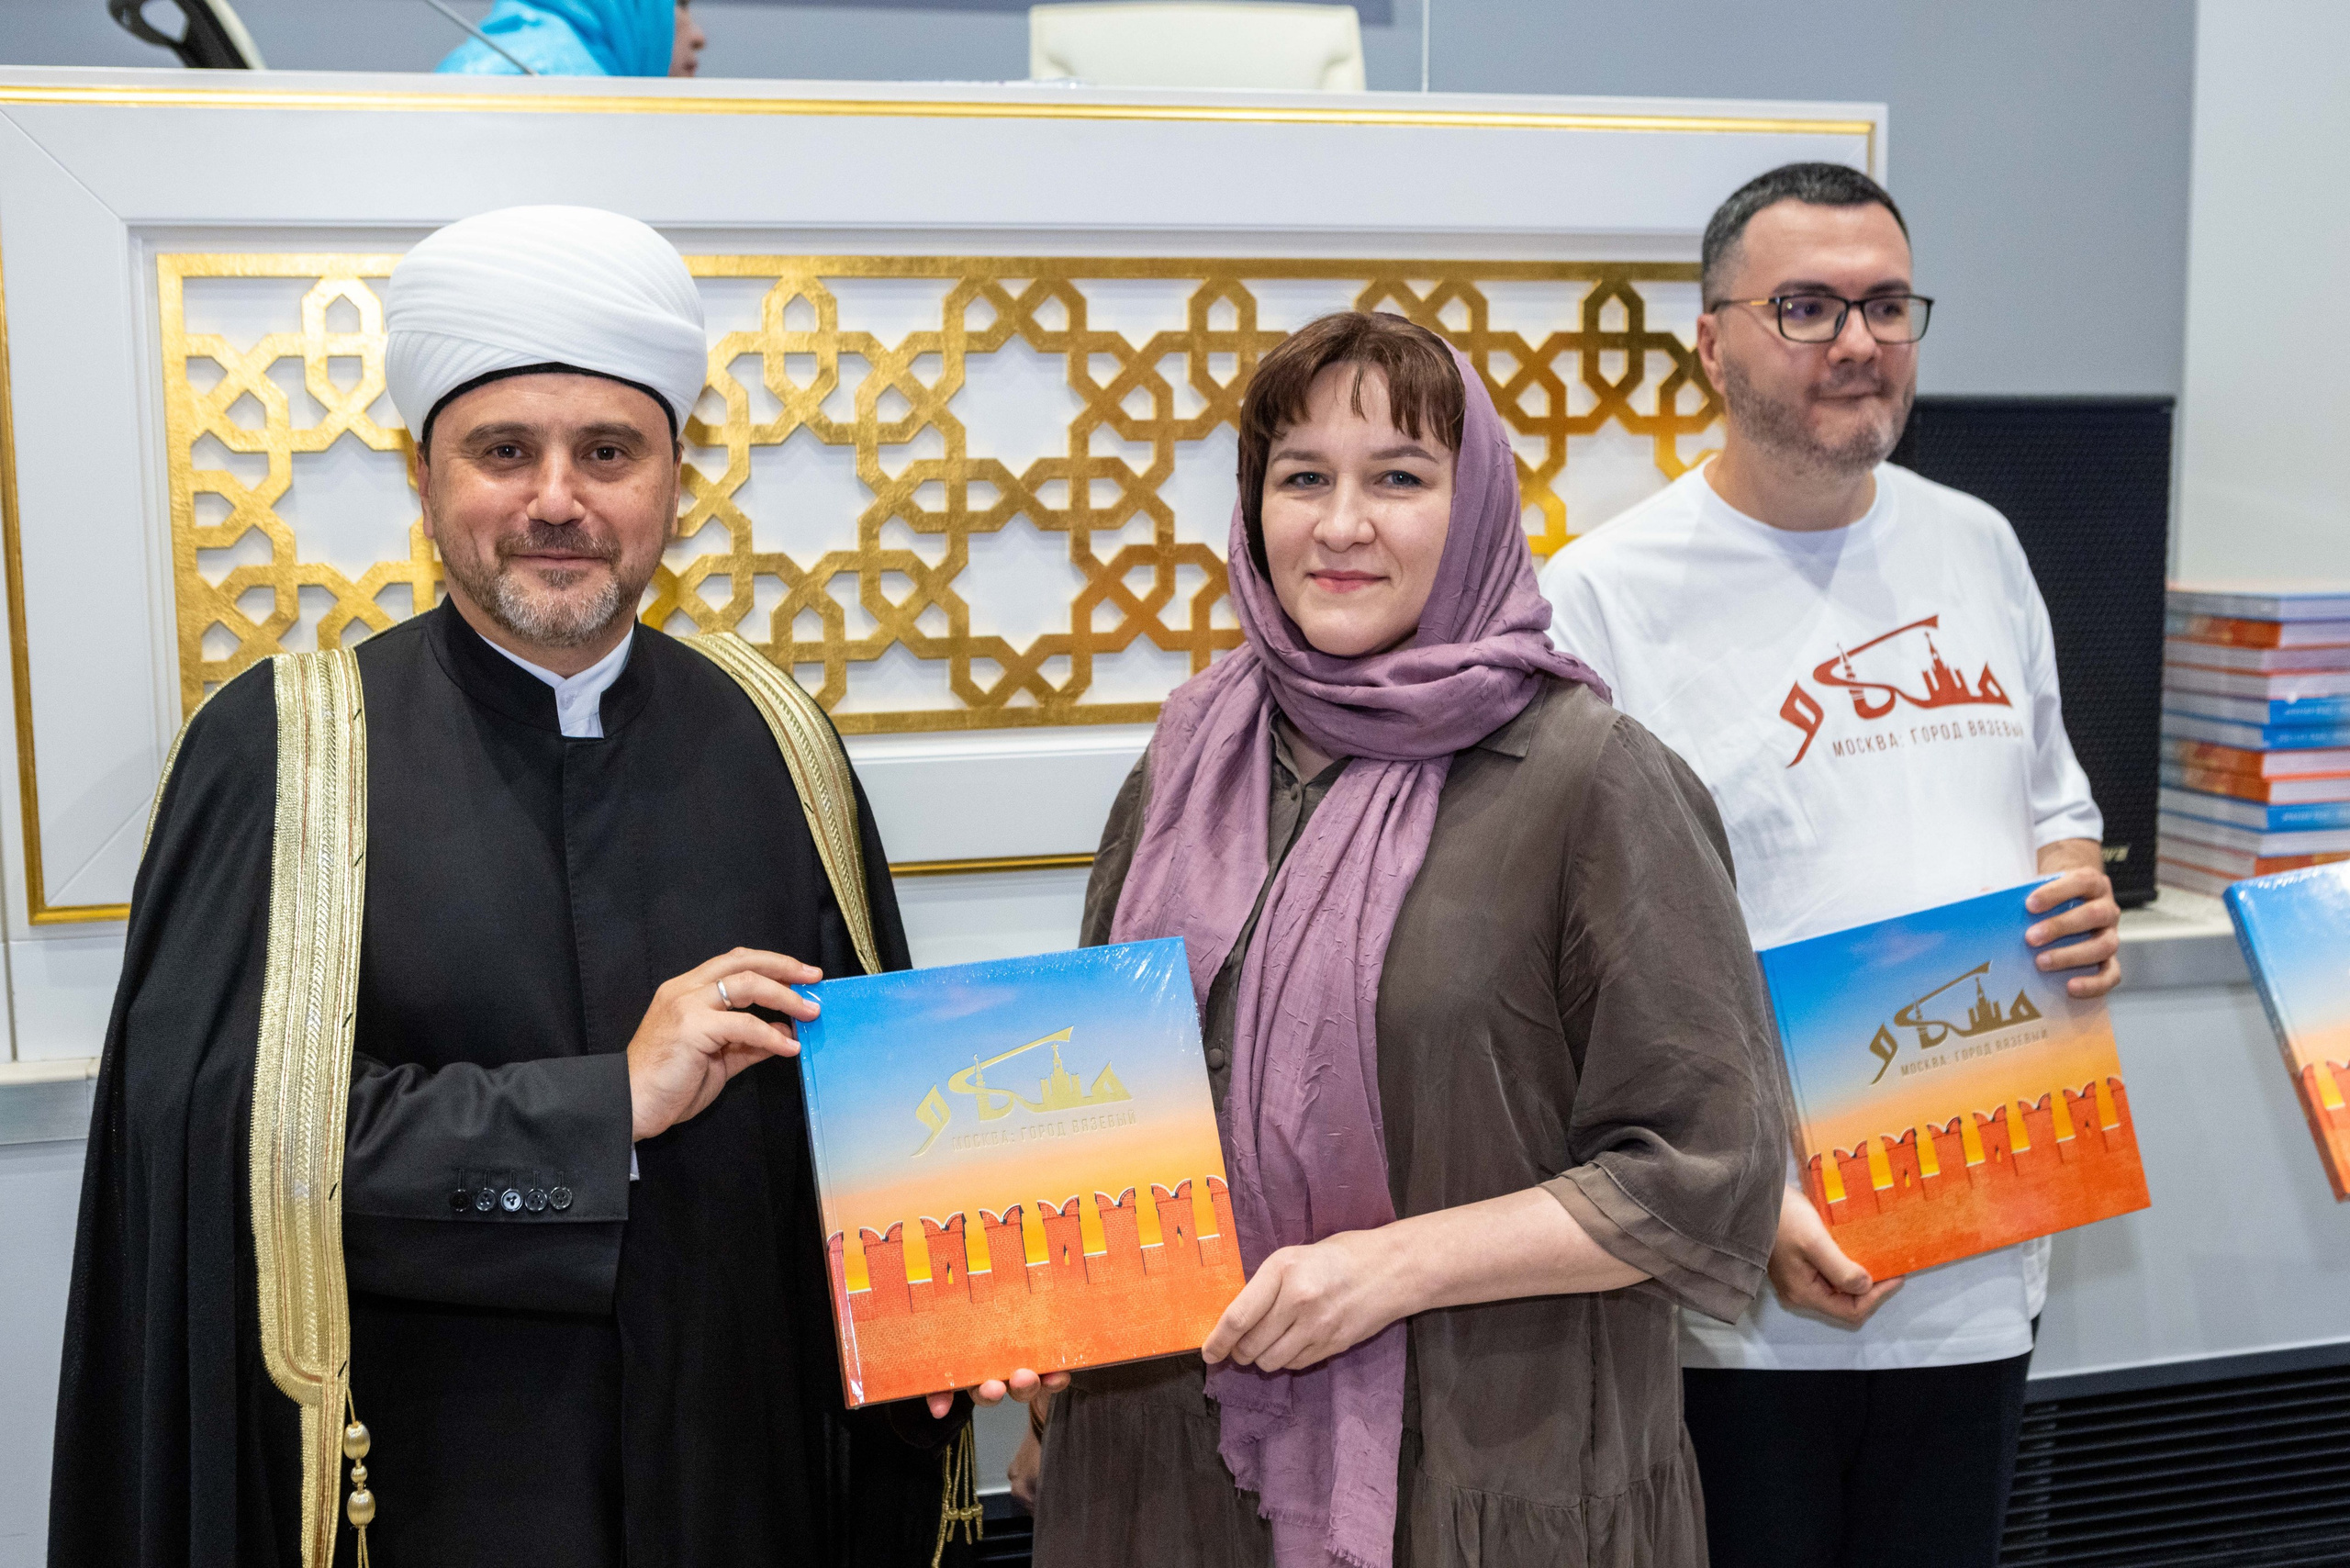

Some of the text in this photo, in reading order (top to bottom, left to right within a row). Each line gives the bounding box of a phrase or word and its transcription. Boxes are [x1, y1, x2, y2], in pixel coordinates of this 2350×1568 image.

[1910, 722, 1963, 745] ГОРОД
[1954, 1042, 1991, 1063] ГОРОД
[952, 1110, 1137, 1151] МОСКВА: ГОРОД ВЯЗЕВЫЙ
